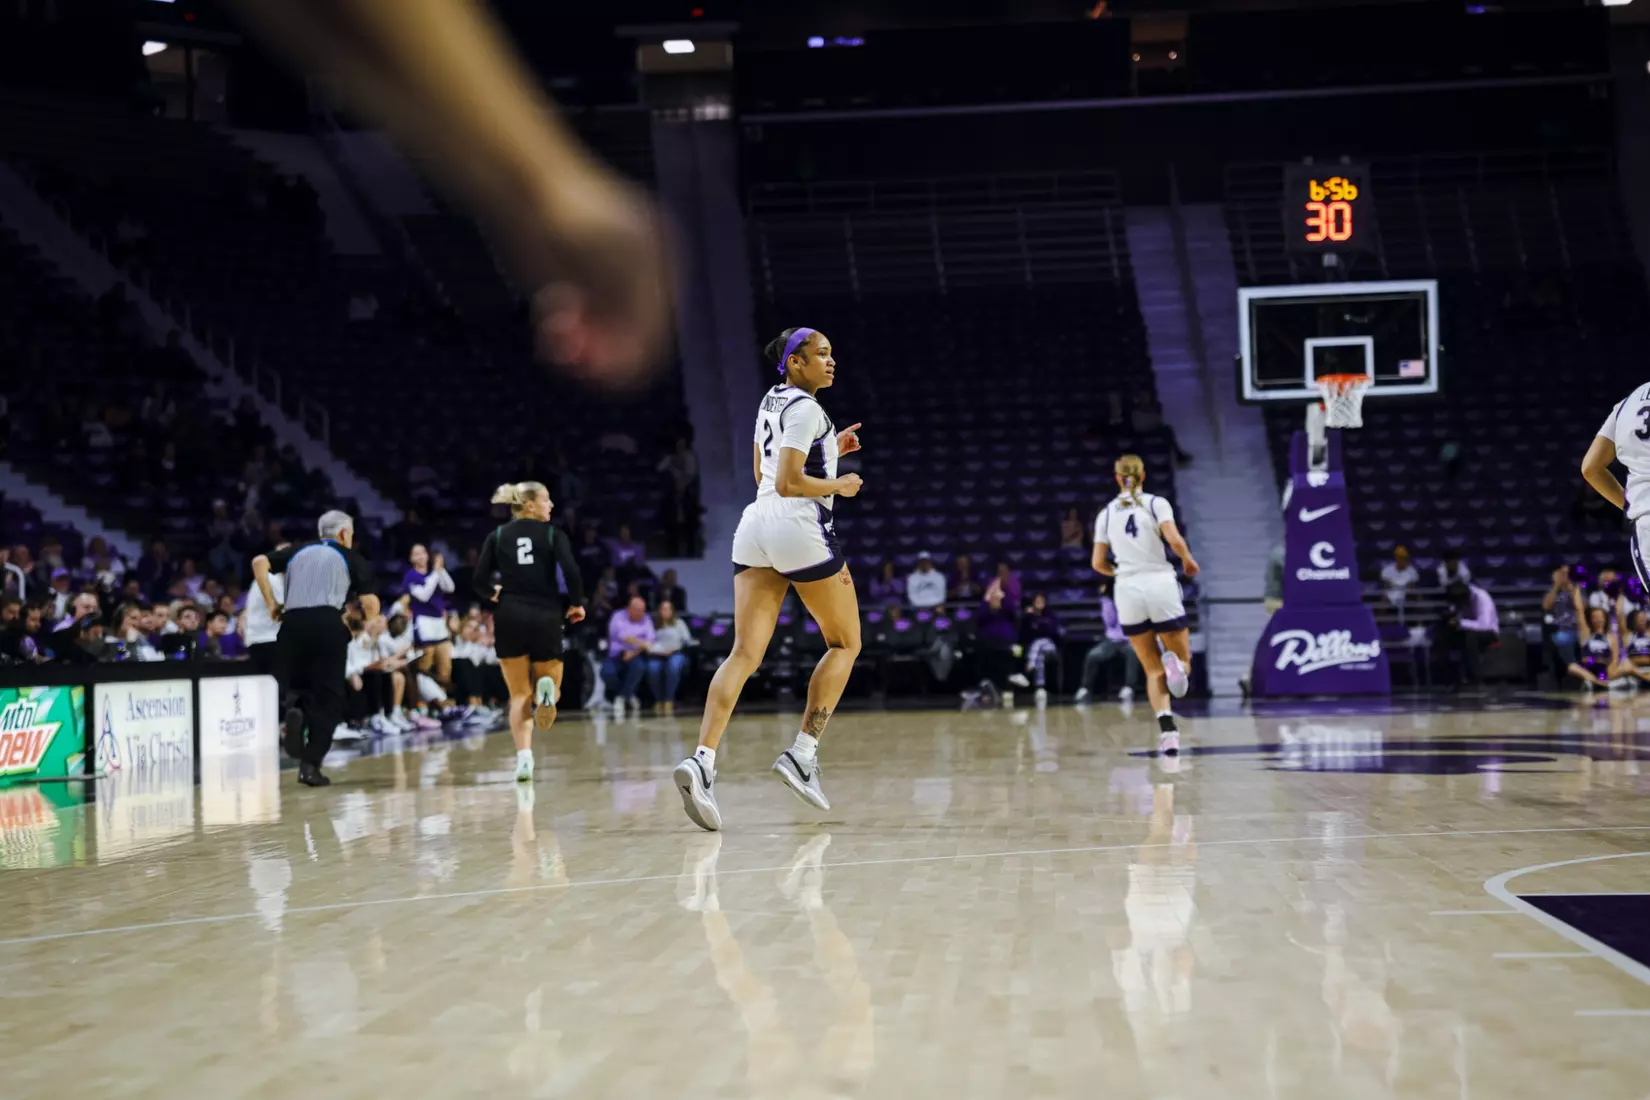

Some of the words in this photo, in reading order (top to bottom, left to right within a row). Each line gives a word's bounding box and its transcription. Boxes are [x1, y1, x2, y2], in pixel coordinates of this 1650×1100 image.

[1305, 202, 1352, 242] 30
[763, 418, 773, 456] 2
[1125, 513, 1138, 538] 4
[517, 536, 534, 564] 2
[1270, 629, 1381, 672] Dillons
[126, 687, 186, 722] Ascension
[126, 735, 147, 769] Via
